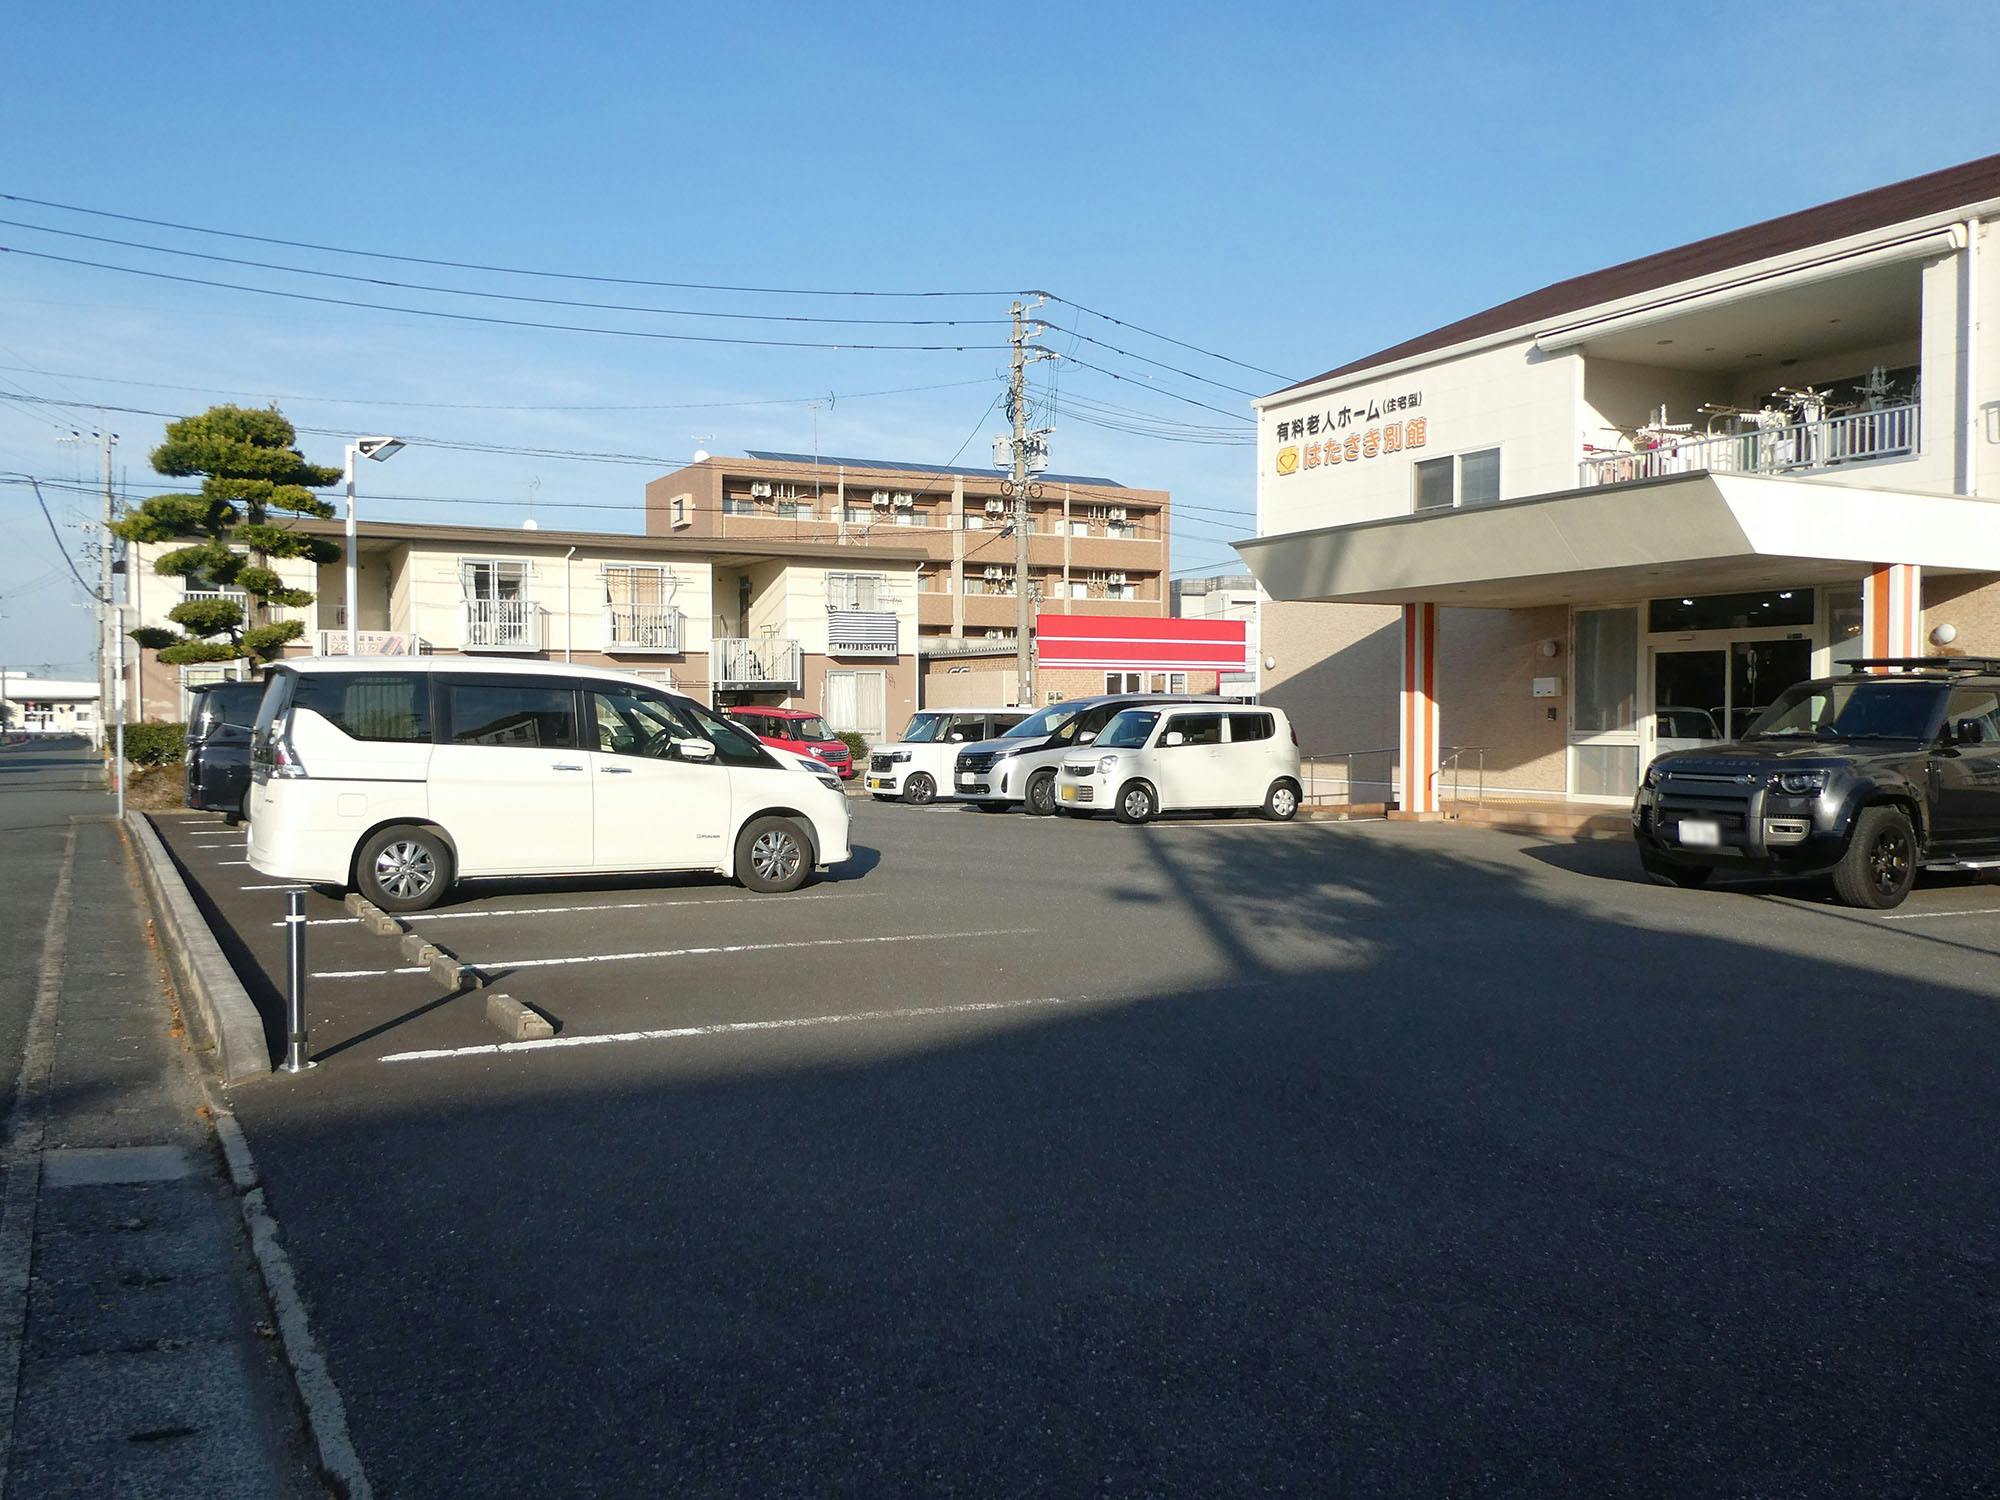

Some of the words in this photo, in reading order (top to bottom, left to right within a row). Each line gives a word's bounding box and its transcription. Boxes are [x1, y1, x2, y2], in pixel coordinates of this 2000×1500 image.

[1302, 417, 1427, 470] はたさき別館
